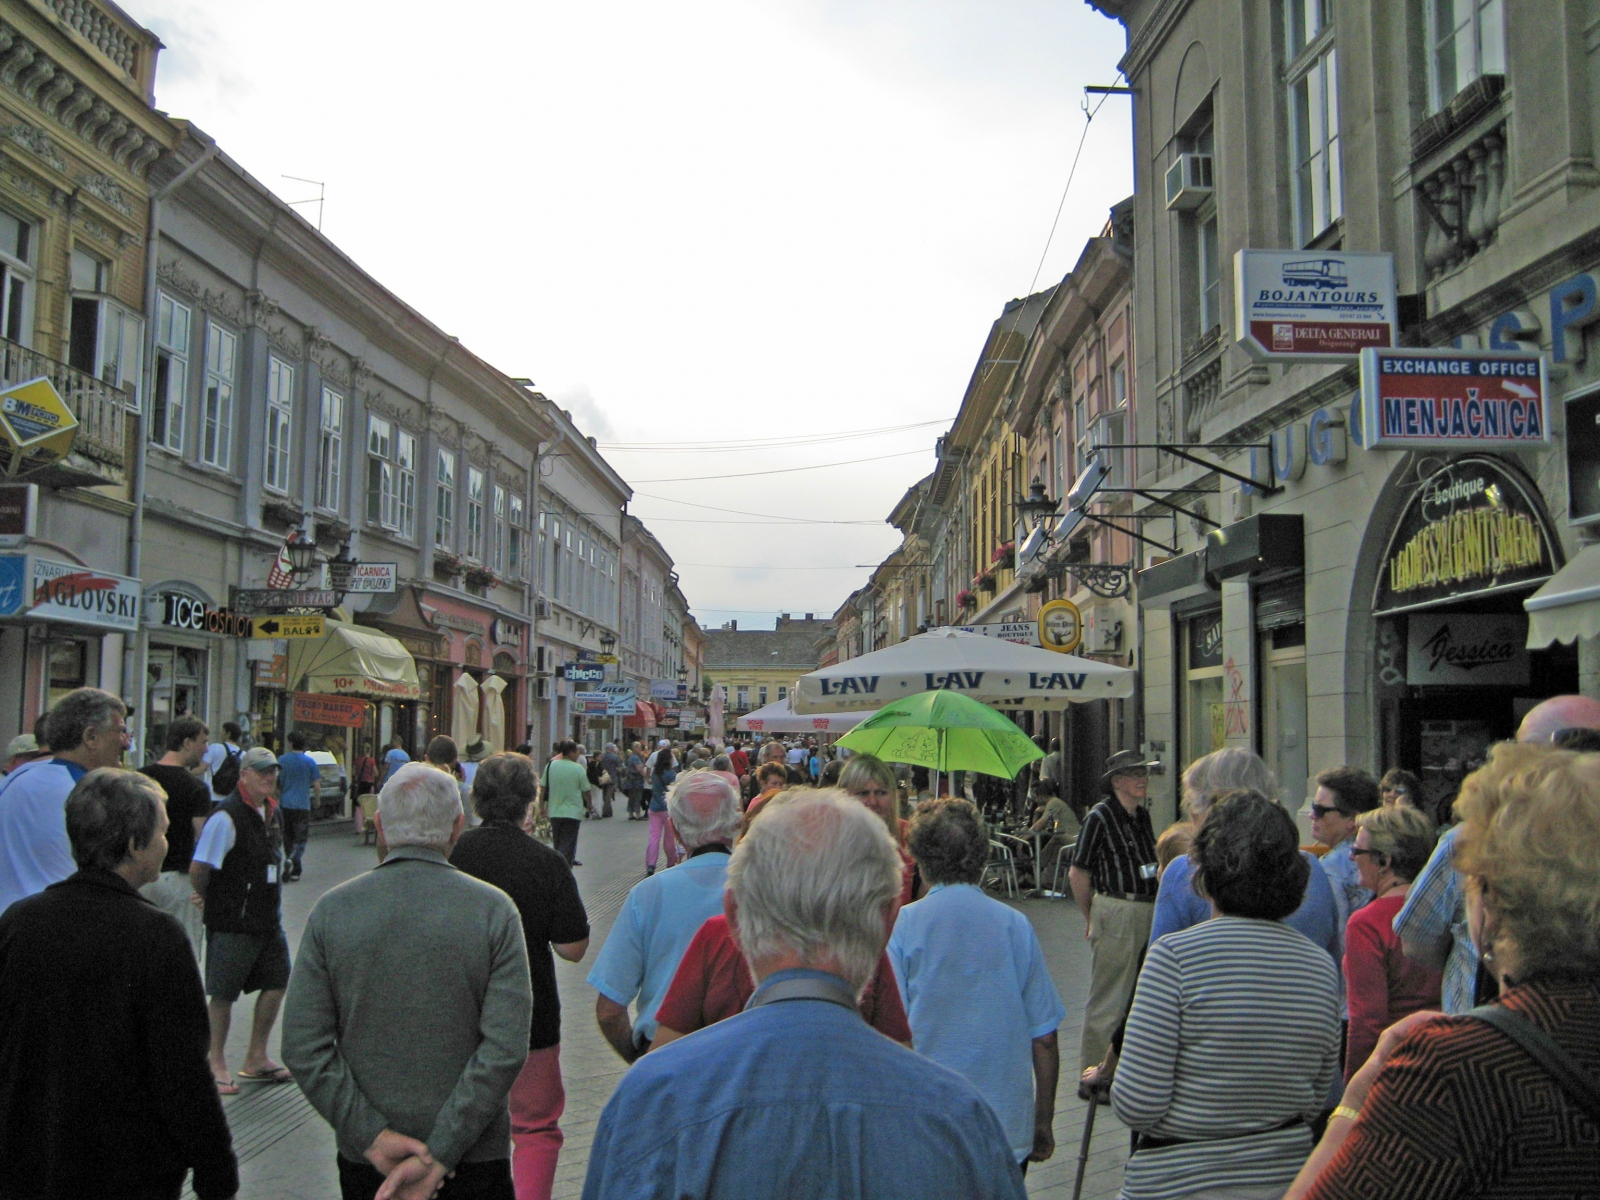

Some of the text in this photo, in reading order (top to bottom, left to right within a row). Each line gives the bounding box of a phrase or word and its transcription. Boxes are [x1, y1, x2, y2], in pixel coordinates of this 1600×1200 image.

[1259, 289, 1378, 303] BOJANTOURS
[1295, 328, 1381, 340] DELTA GENERALI
[1382, 360, 1537, 376] EXCHANGE OFFICE
[1382, 388, 1542, 438] MENJAČNICA
[1434, 476, 1485, 505] boutique
[1000, 623, 1030, 632] JEANS
[1422, 624, 1516, 673] Jessica
[565, 665, 603, 679] chicco
[925, 671, 985, 690] LAV
[1028, 672, 1088, 690] LAV
[819, 675, 881, 696] LAV
